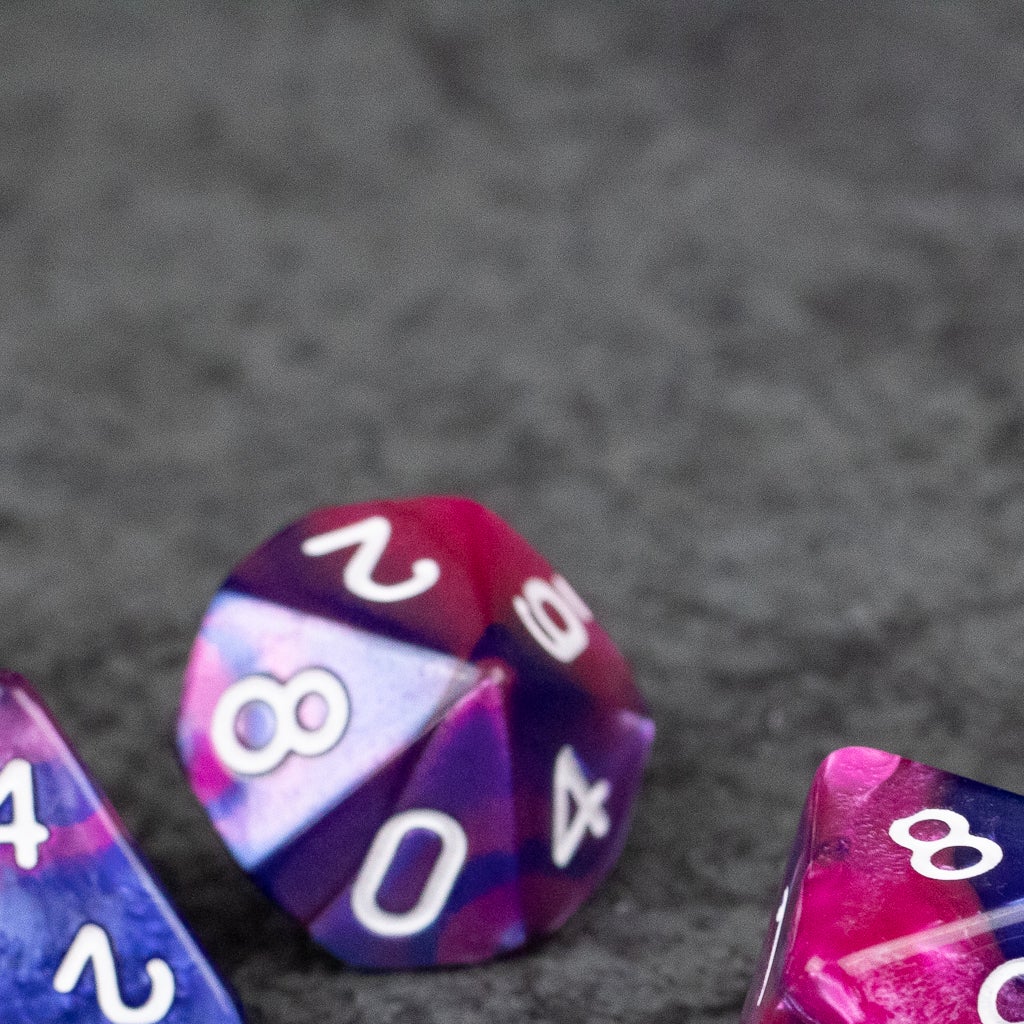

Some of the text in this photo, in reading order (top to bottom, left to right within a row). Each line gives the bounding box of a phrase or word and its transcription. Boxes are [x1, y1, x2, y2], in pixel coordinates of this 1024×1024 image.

[302, 515, 440, 603] 2
[210, 665, 351, 776] 8
[0, 757, 51, 871] 4
[552, 744, 611, 868] 4
[887, 807, 1004, 881] 8
[350, 809, 469, 938] 0
